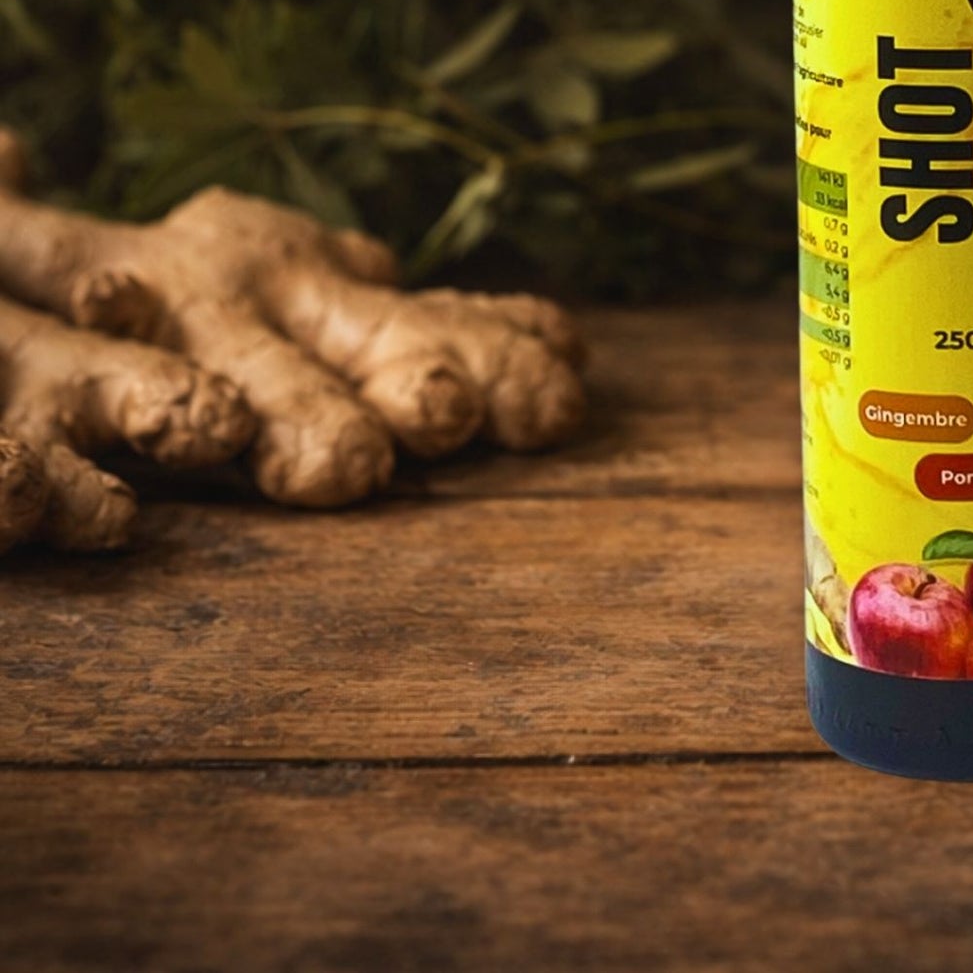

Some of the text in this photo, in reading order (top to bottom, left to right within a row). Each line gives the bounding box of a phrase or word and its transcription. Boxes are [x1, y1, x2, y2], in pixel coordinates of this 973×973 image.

[827, 193, 848, 210] kcal
[840, 223, 848, 236] g
[840, 246, 849, 259] g
[841, 268, 849, 281] g
[842, 290, 850, 304] g
[842, 313, 850, 325] g
[842, 335, 851, 347] g
[843, 357, 851, 370] g
[865, 405, 968, 428] Gingembre
